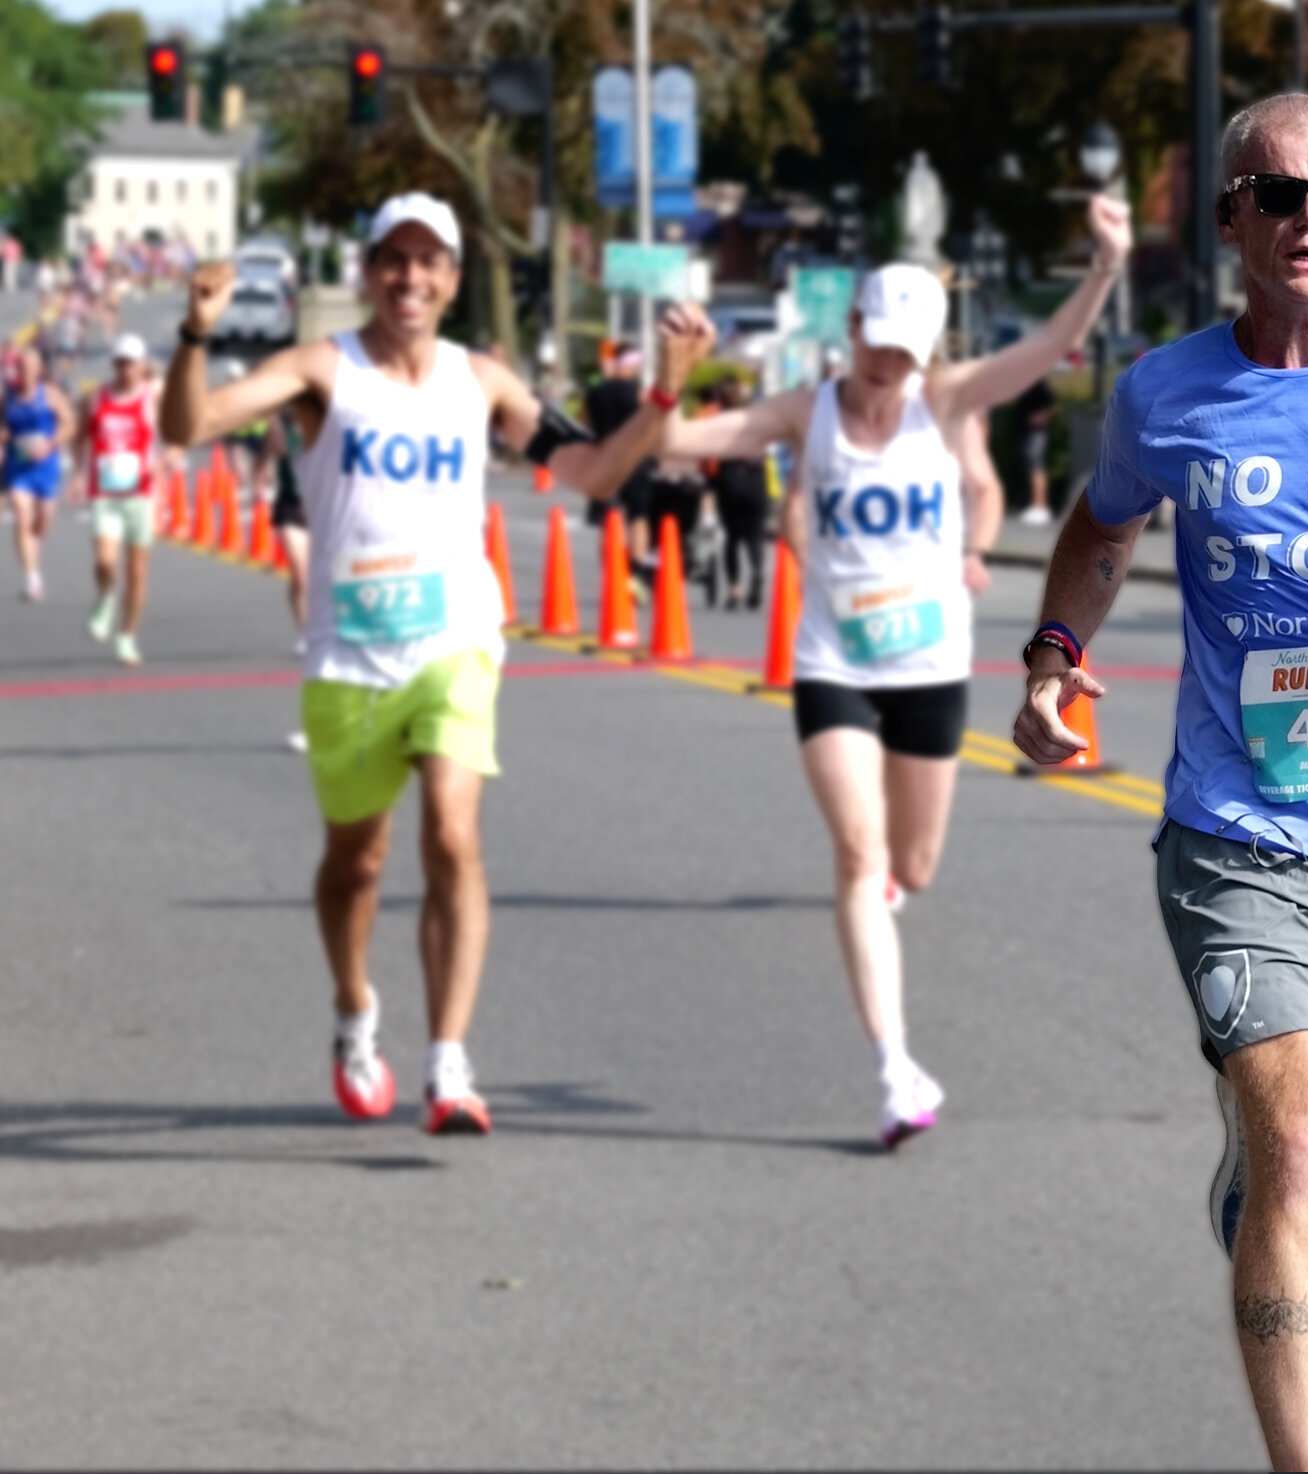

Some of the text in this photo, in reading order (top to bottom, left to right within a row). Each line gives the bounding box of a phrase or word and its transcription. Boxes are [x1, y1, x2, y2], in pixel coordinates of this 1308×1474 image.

[341, 426, 465, 484] KOH
[1185, 455, 1283, 511] NO
[814, 480, 944, 538] KOH
[357, 580, 422, 611] 972
[1271, 650, 1308, 667] North
